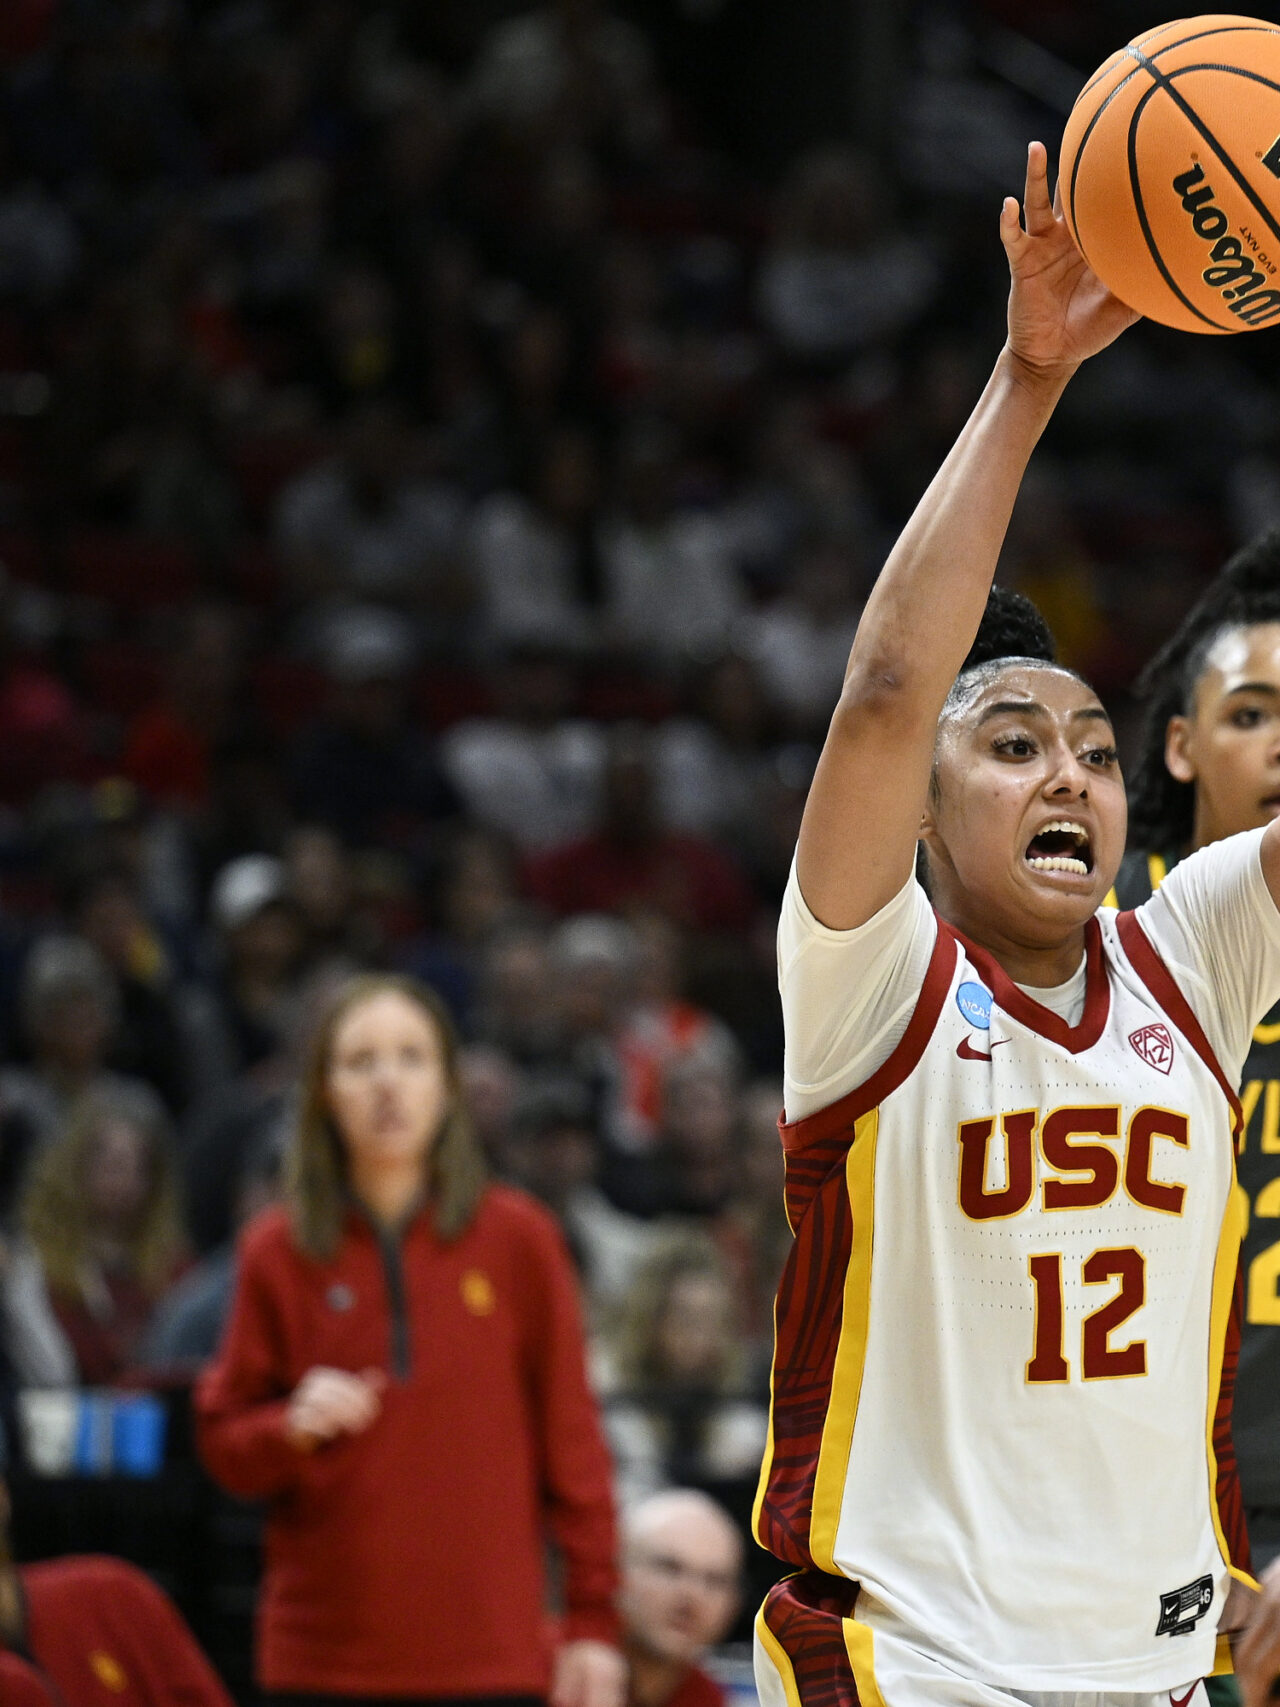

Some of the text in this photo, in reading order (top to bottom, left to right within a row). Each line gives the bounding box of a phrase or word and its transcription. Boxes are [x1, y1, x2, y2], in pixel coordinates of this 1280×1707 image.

[1239, 225, 1278, 276] EVO NXT
[1148, 1045, 1169, 1064] 12
[957, 1104, 1191, 1223] USC
[1023, 1245, 1148, 1385] 12
